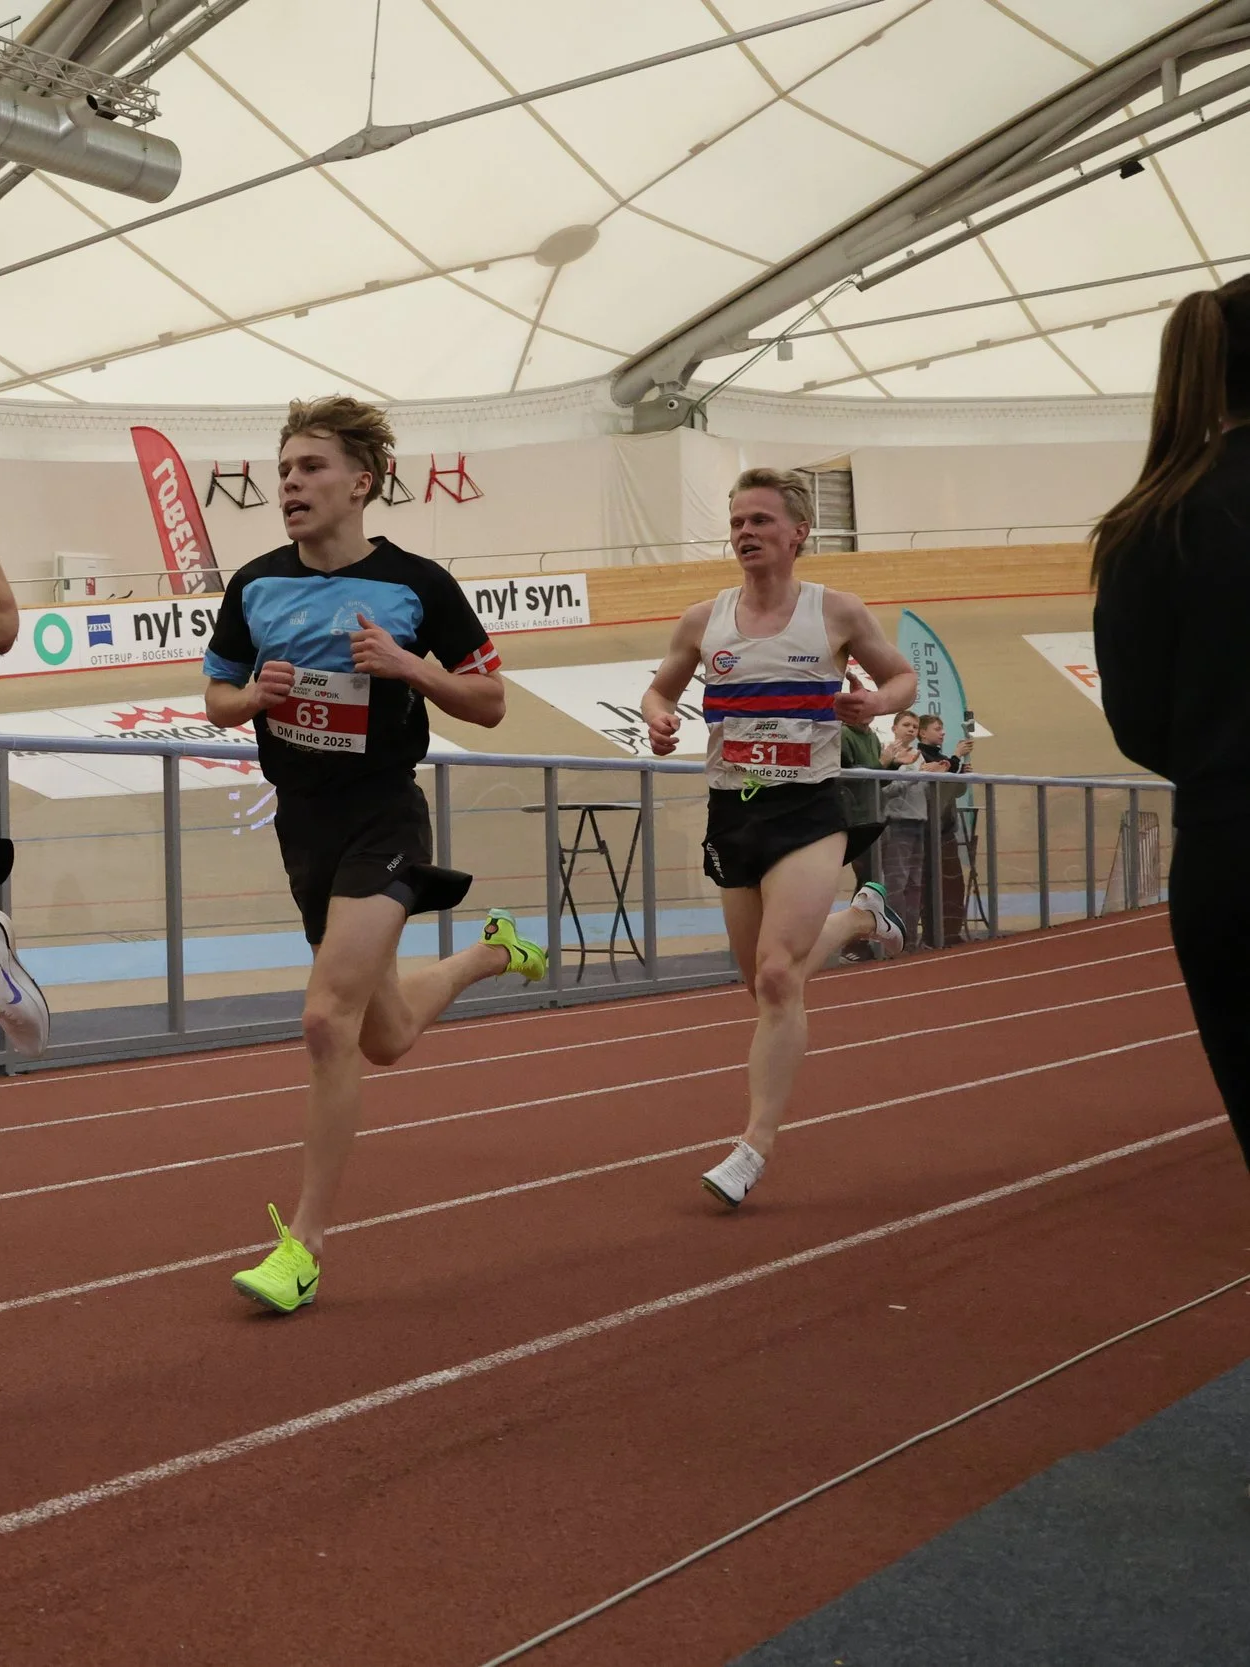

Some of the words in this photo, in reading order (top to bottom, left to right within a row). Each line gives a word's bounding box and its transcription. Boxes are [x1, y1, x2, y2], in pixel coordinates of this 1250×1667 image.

[475, 580, 519, 620] nyt
[524, 583, 582, 617] syn.
[87, 621, 112, 633] ZEISS
[132, 602, 183, 648] nyt
[190, 609, 222, 638] sy
[483, 621, 519, 631] BOGENSE
[533, 617, 560, 627] Anders
[90, 653, 133, 666] OTTERUP
[142, 649, 184, 661] BOGENSE
[787, 655, 820, 663] TRIMTEX
[295, 702, 330, 730] 63
[277, 725, 293, 739] DM
[296, 730, 320, 744] inde
[323, 735, 353, 748] 2025
[750, 743, 779, 765] 51
[775, 769, 799, 779] 2025
